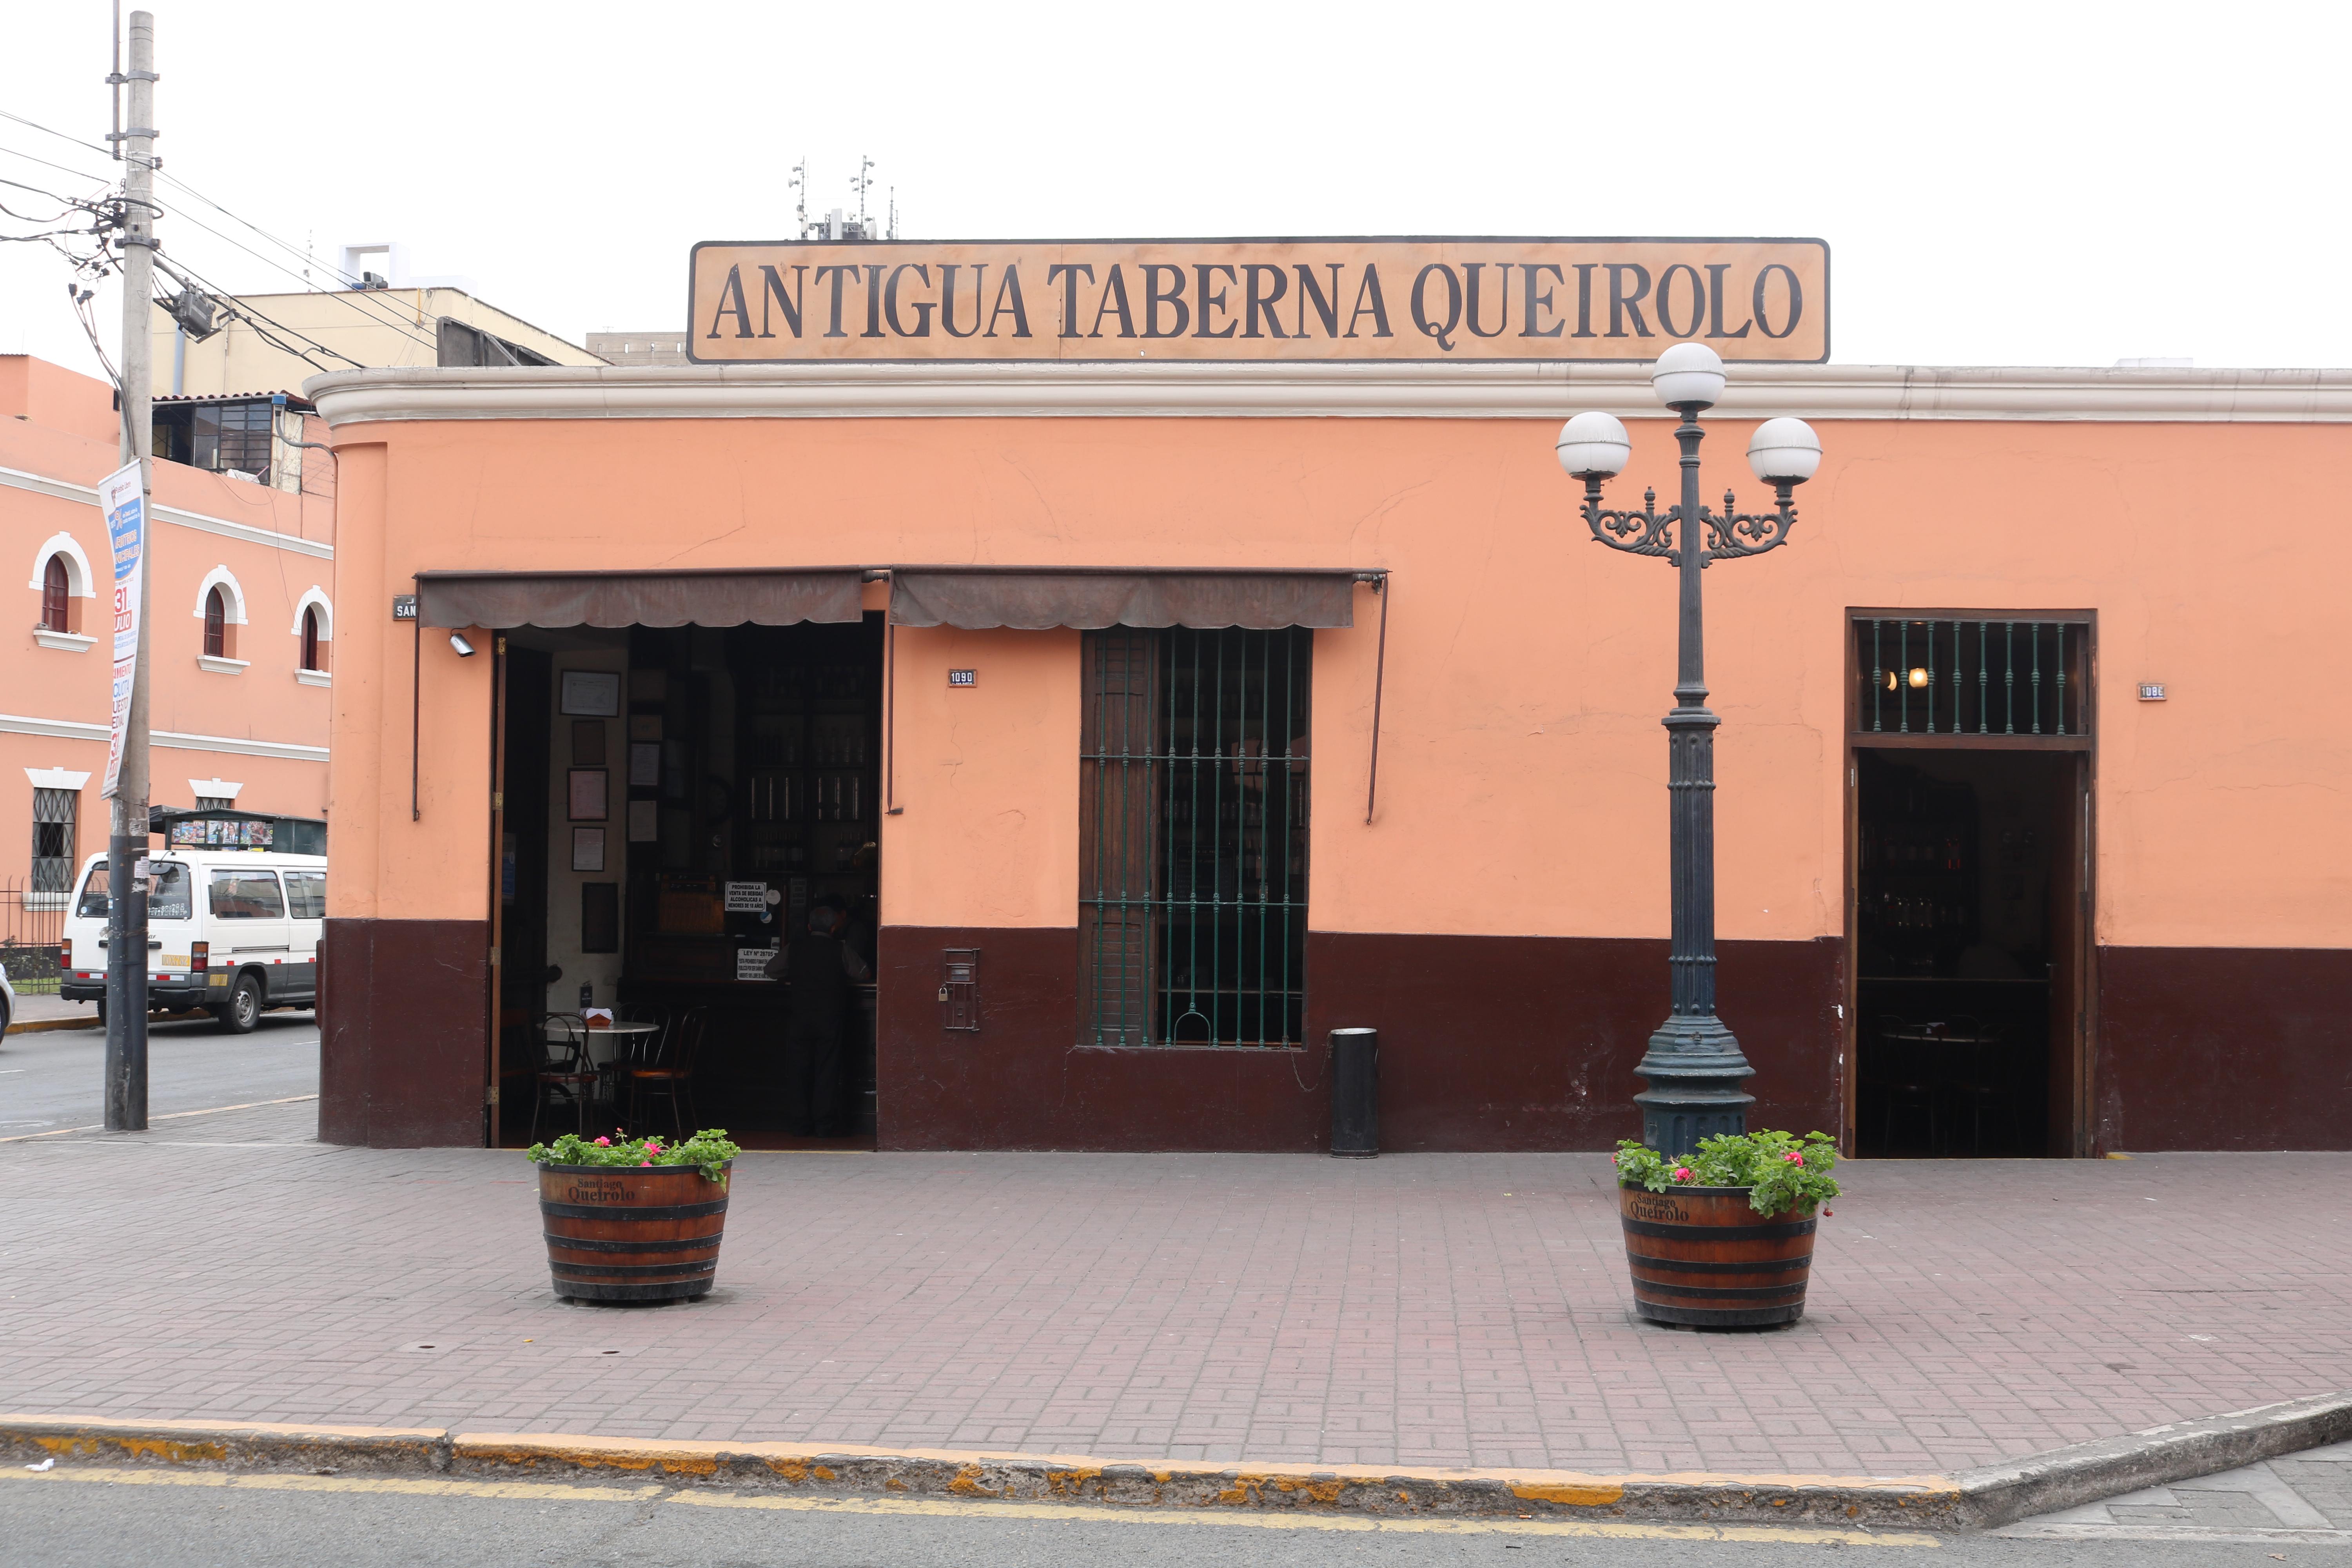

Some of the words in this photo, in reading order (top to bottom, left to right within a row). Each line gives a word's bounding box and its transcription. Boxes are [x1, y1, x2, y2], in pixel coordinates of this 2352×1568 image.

[706, 263, 1033, 339] ANTIGUA
[1047, 263, 1394, 339] TABERNA
[1410, 263, 1802, 352] QUEIROLO
[115, 586, 127, 613] 31
[397, 605, 416, 616] SAN
[114, 613, 130, 632] ULIO
[951, 672, 972, 682] 1090
[113, 697, 129, 714] UESTO
[577, 1178, 622, 1191] Santiago
[568, 1186, 635, 1203] Queirolo
[1637, 1193, 1676, 1209] Santiago
[1630, 1201, 1689, 1221] Queirolo
